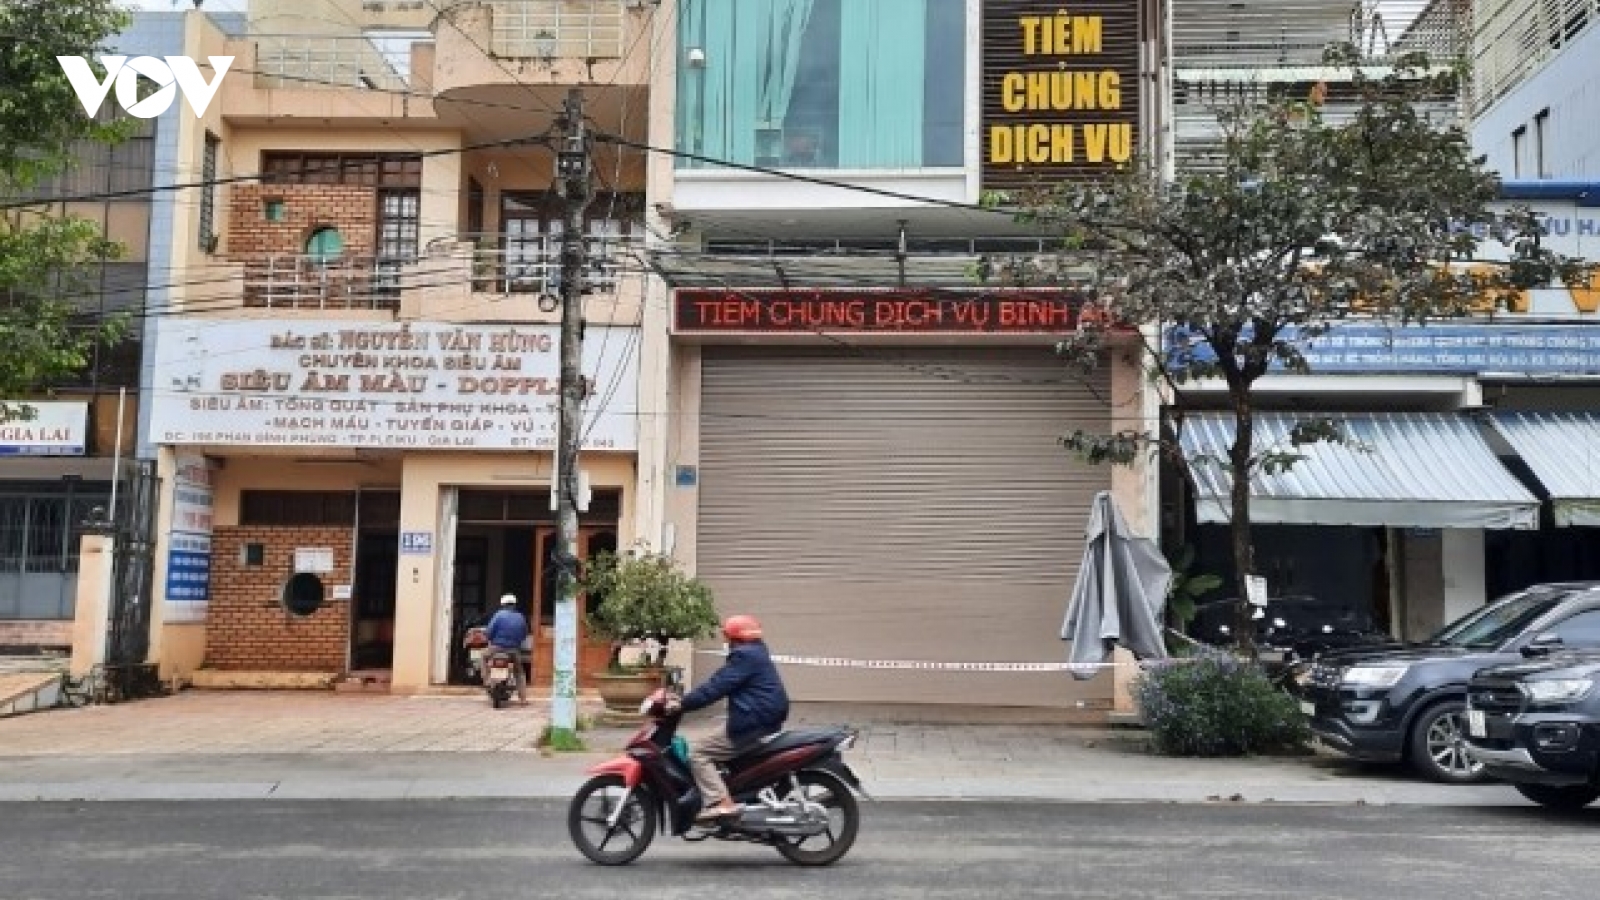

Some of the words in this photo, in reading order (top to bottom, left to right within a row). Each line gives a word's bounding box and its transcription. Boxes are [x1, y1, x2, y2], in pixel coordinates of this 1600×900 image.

[1019, 9, 1102, 54] TIÊM
[1003, 61, 1120, 112] CHỦNG
[991, 124, 1073, 170] DỊCH
[1083, 124, 1131, 170] VỤ
[695, 294, 760, 325] TIÊM
[769, 294, 865, 326] CHỦNG
[953, 301, 989, 331] VỤ
[338, 324, 429, 350] NGUYỄN
[436, 327, 482, 350] VĂN
[299, 352, 378, 367] CHUYÊN
[383, 356, 438, 369] KHOA
[443, 353, 487, 370] SIÊU
[491, 355, 521, 370] ÂM
[220, 369, 291, 391] SIÊU
[300, 370, 349, 392] ÂM
[360, 370, 428, 393] MÀU
[190, 397, 231, 411] SIÊU
[480, 402, 529, 415] KHOA
[40, 427, 70, 441] LAI
